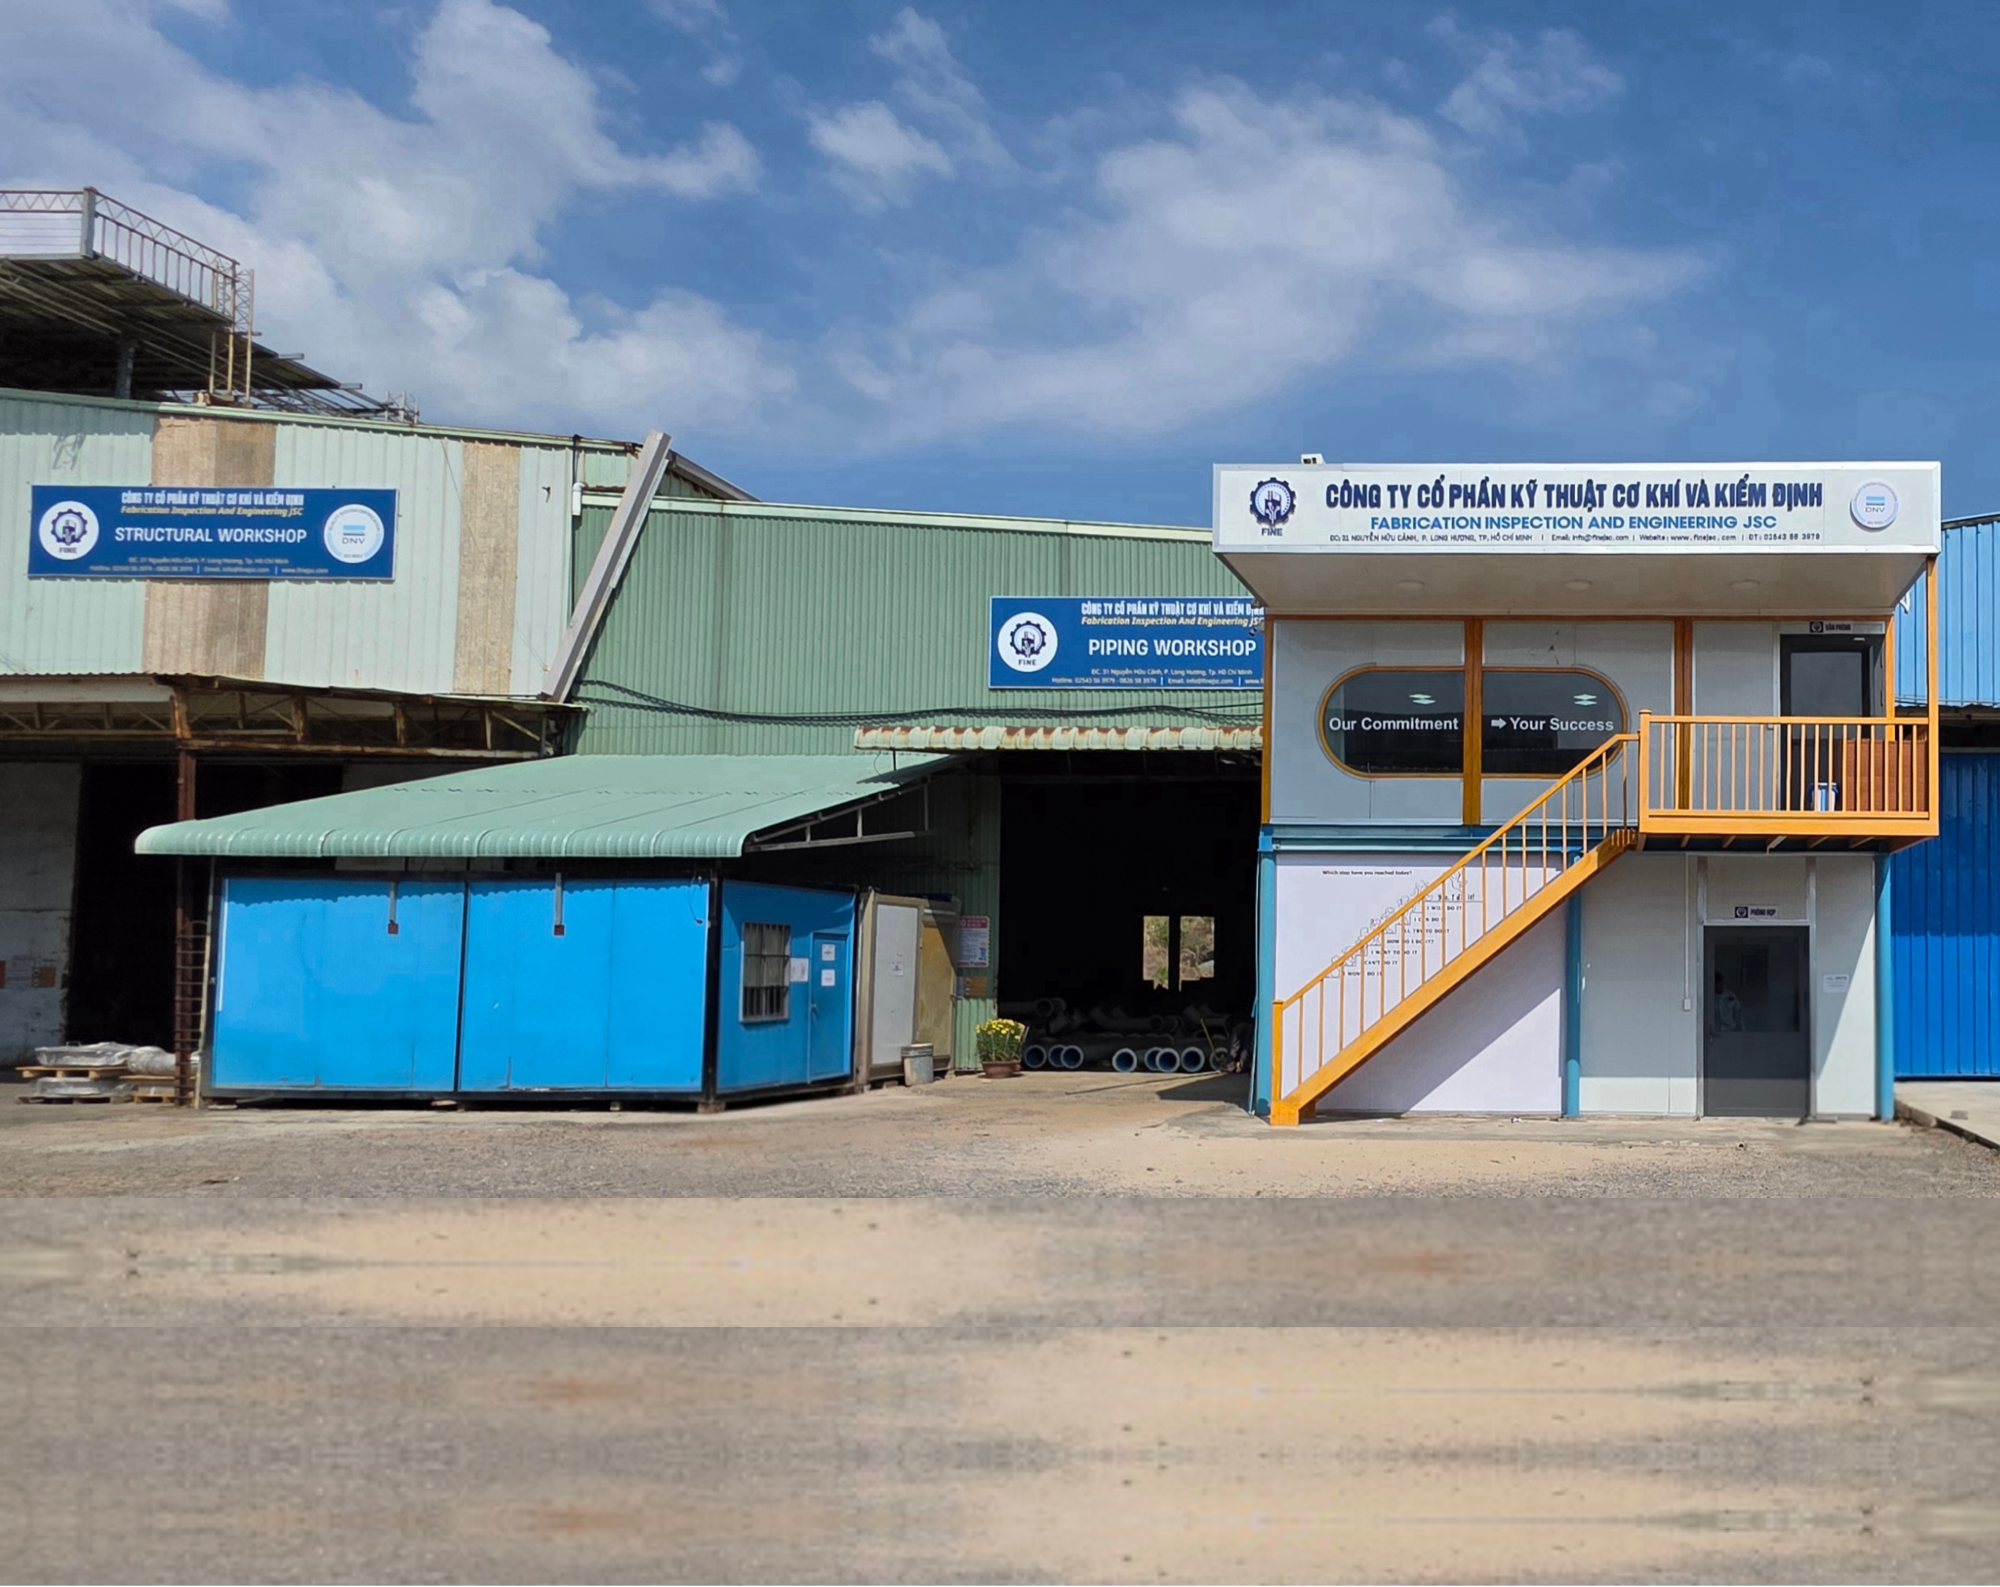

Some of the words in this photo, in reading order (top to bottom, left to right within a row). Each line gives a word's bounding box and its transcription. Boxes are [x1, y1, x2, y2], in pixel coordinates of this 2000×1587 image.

[1326, 478, 1381, 508] CÔNG
[1387, 484, 1412, 508] TY
[1417, 474, 1445, 508] CỔ
[1449, 476, 1506, 508] PHẦN
[1511, 479, 1538, 508] KỸ
[1544, 479, 1607, 512] THUẬT
[1612, 482, 1641, 508] CƠ
[1646, 479, 1681, 508] KHÍ
[1686, 479, 1710, 508] VÀ
[1715, 474, 1766, 508] KIỂM
[1772, 482, 1823, 512] ĐỊNH
[121, 506, 170, 514] Fabrication
[218, 507, 236, 515] And
[237, 507, 288, 517] Engineering
[1371, 516, 1481, 530] FABRICATION
[1485, 516, 1583, 529] INSPECTION
[1588, 516, 1624, 529] AND
[1629, 516, 1737, 529] ENGINEERING
[1743, 516, 1777, 529] JSC
[115, 527, 213, 542] STRUCTURAL
[218, 528, 307, 543] WORKSHOP
[1261, 528, 1283, 536] FINE
[1081, 601, 1102, 615] CÔNG
[1103, 603, 1113, 615] TY
[1213, 601, 1224, 615] VÀ
[1081, 616, 1130, 625] Fabrication
[1131, 617, 1176, 627] Inspection
[1178, 617, 1195, 625] And
[1197, 617, 1248, 627] Engineering
[1089, 639, 1149, 656] PIPING
[1153, 639, 1257, 656] WORKSHOP
[1328, 717, 1357, 731] Our
[1361, 717, 1459, 731] Commitment
[1509, 717, 1546, 731] Your
[1549, 717, 1614, 731] Success
